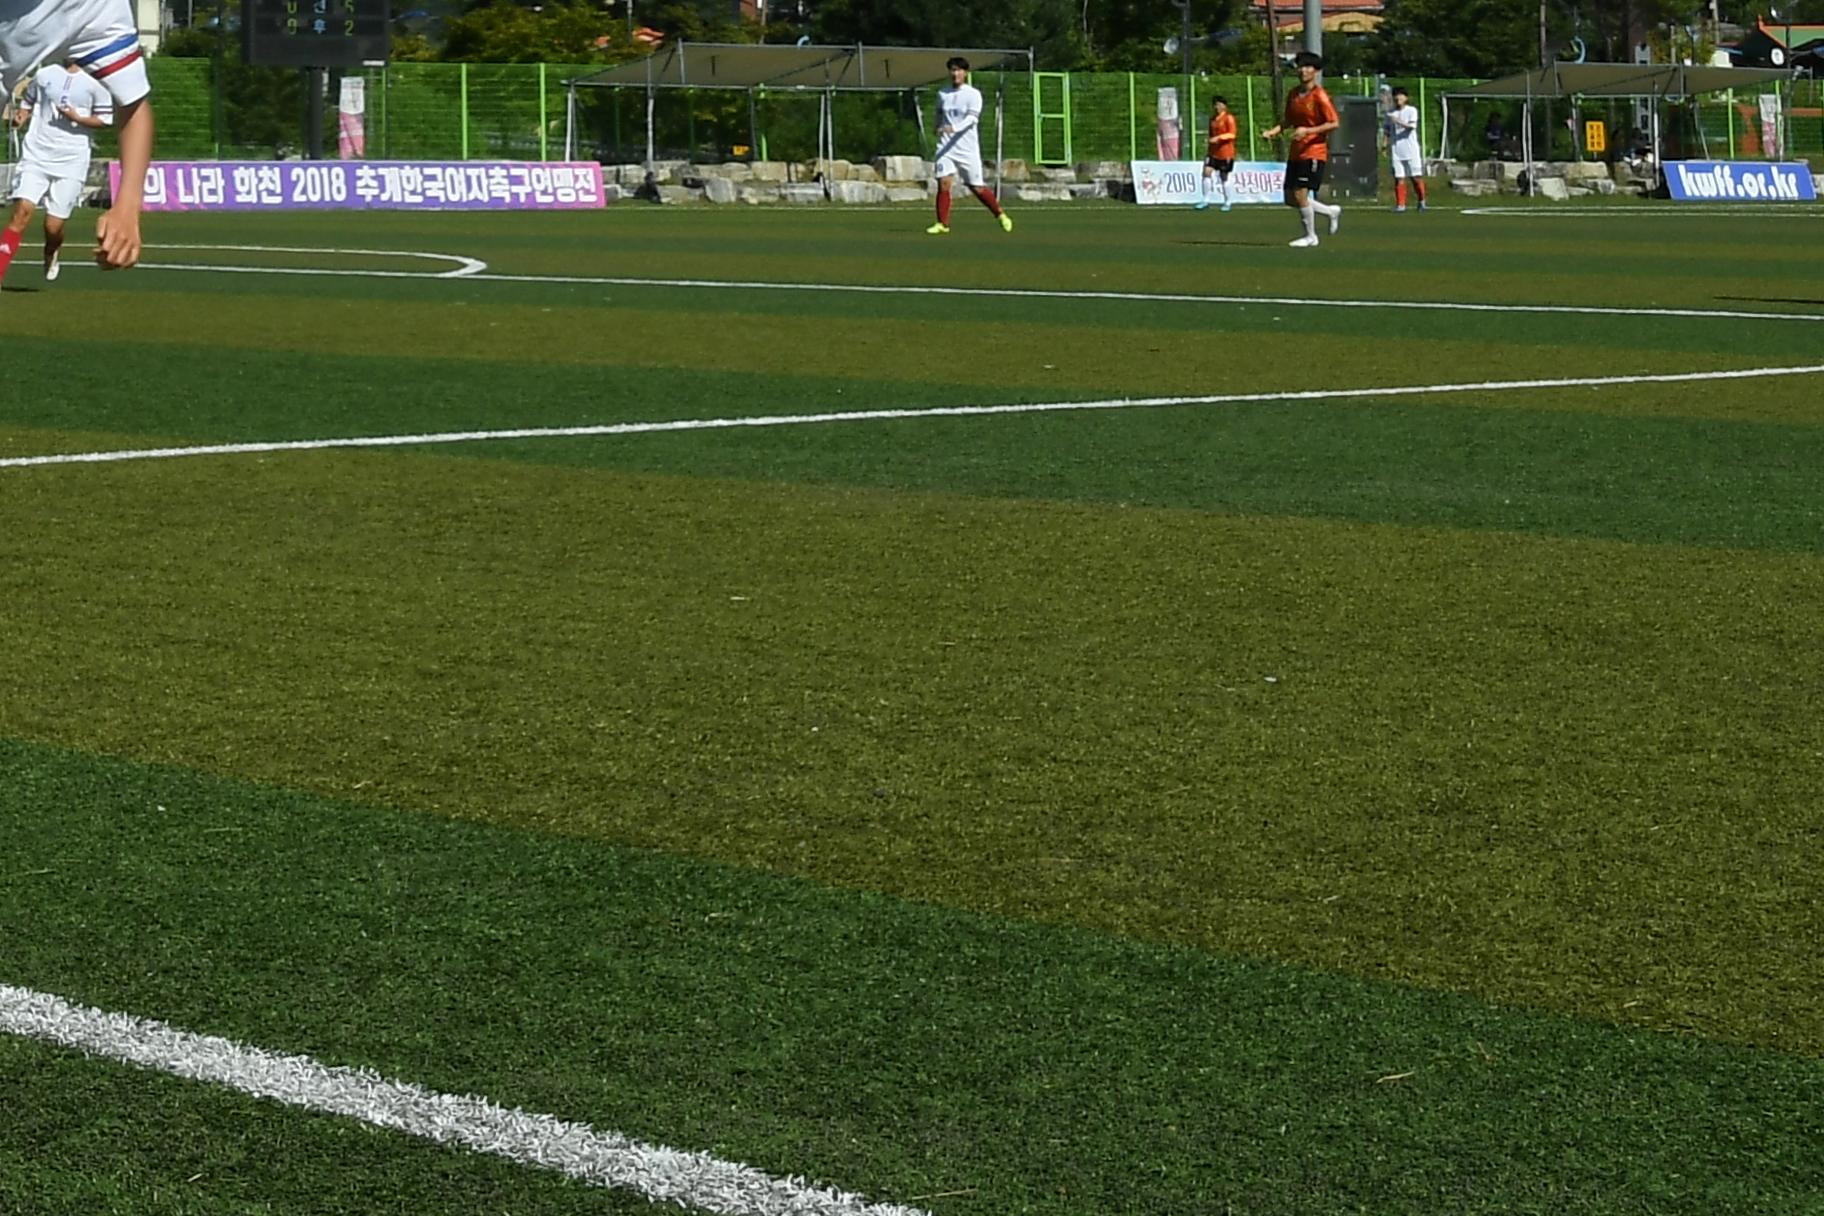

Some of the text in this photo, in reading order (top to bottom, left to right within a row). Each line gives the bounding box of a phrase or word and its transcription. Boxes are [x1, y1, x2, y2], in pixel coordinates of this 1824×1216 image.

[345, 20, 354, 36] 2
[176, 167, 225, 204] 나라
[233, 166, 283, 204] 화천
[291, 166, 347, 202] 2018
[354, 164, 598, 204] 추계한국여자축구연맹전
[1164, 172, 1196, 193] 2019
[1678, 164, 1799, 200] kwff.or.kr
